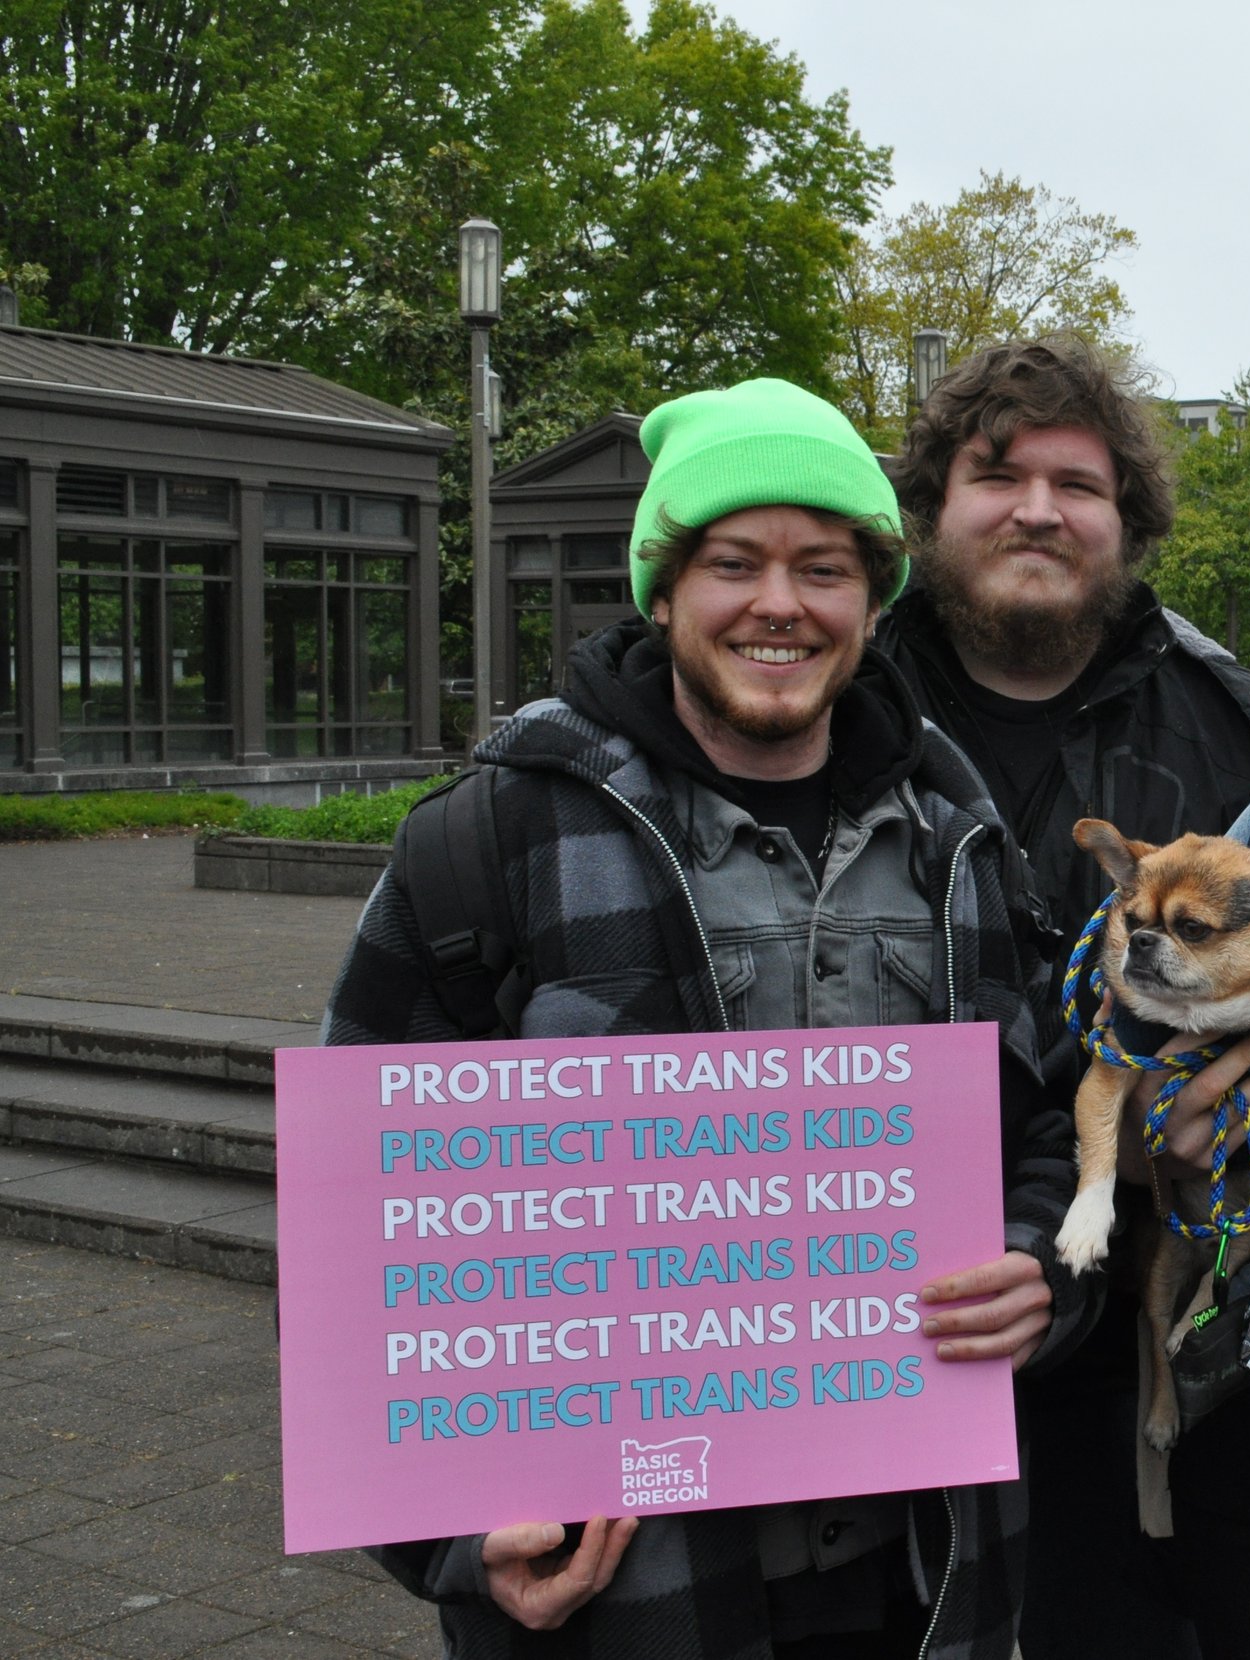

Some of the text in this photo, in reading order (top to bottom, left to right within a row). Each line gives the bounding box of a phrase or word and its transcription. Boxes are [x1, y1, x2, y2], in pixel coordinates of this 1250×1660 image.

[378, 1042, 913, 1107] PROTECT TRANS KIDS
[380, 1104, 916, 1174] PROTECT TRANS KIDS
[383, 1167, 917, 1241] PROTECT TRANS KIDS
[384, 1229, 920, 1309] PROTECT TRANS KIDS
[385, 1292, 922, 1376] PROTECT TRANS KIDS
[387, 1355, 926, 1444] PROTECT TRANS KIDS
[622, 1452, 680, 1473] BASIC
[622, 1469, 694, 1489] RIGHTS
[622, 1485, 709, 1506] OREGON
